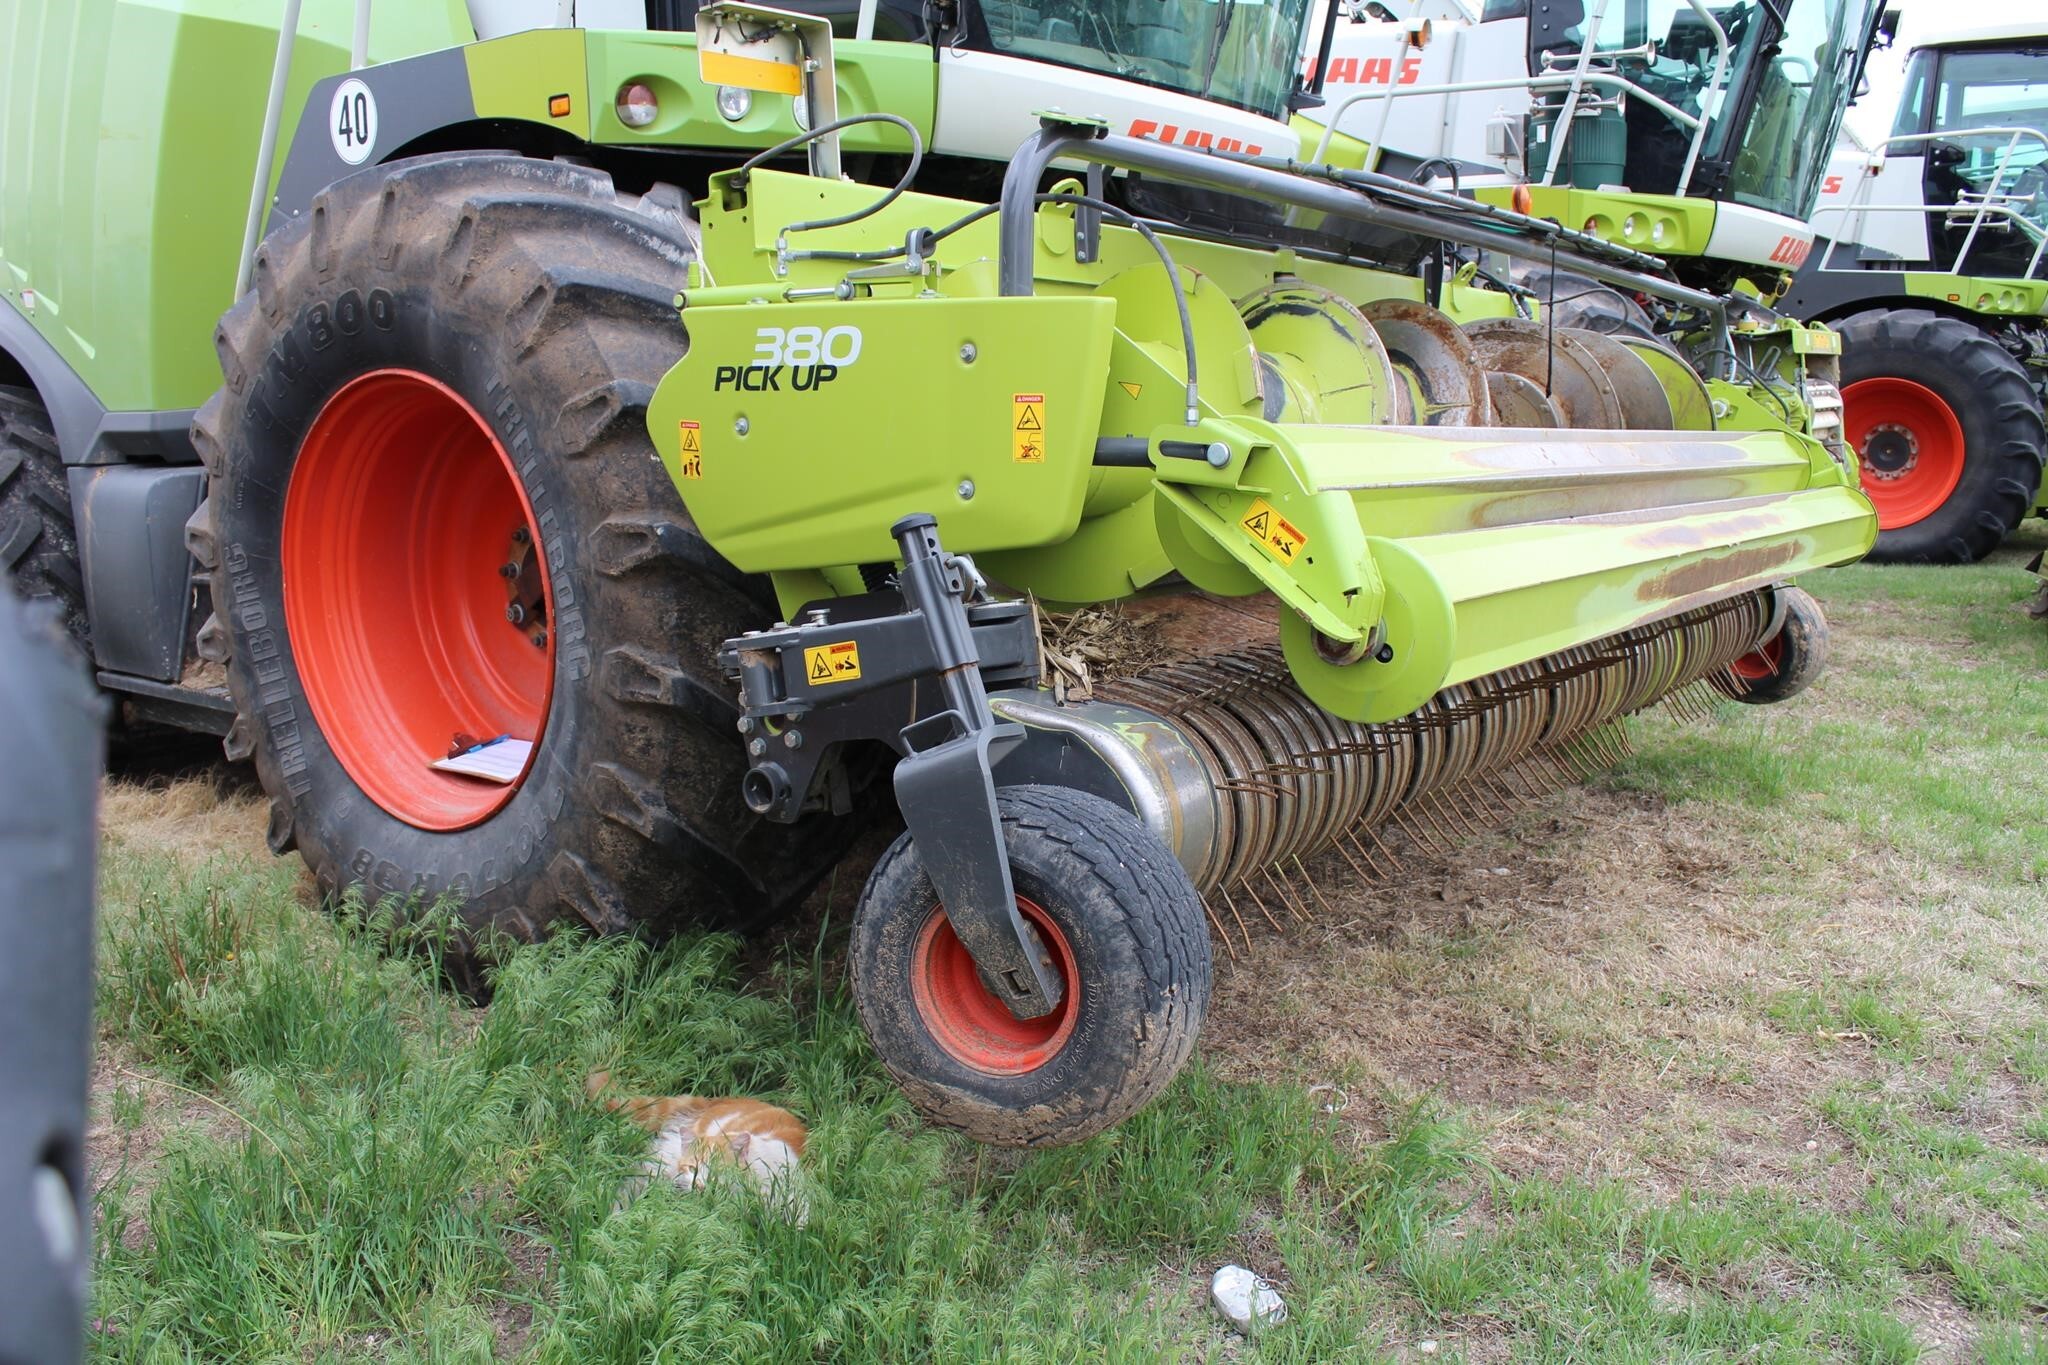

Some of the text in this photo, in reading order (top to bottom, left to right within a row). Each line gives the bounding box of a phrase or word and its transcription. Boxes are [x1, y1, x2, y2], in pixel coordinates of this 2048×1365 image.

[1300, 57, 1422, 84] LAAS
[338, 92, 368, 147] 40
[752, 325, 863, 367] 380
[714, 364, 838, 392] PICK UP
[224, 543, 313, 806] TRELLEBORG
